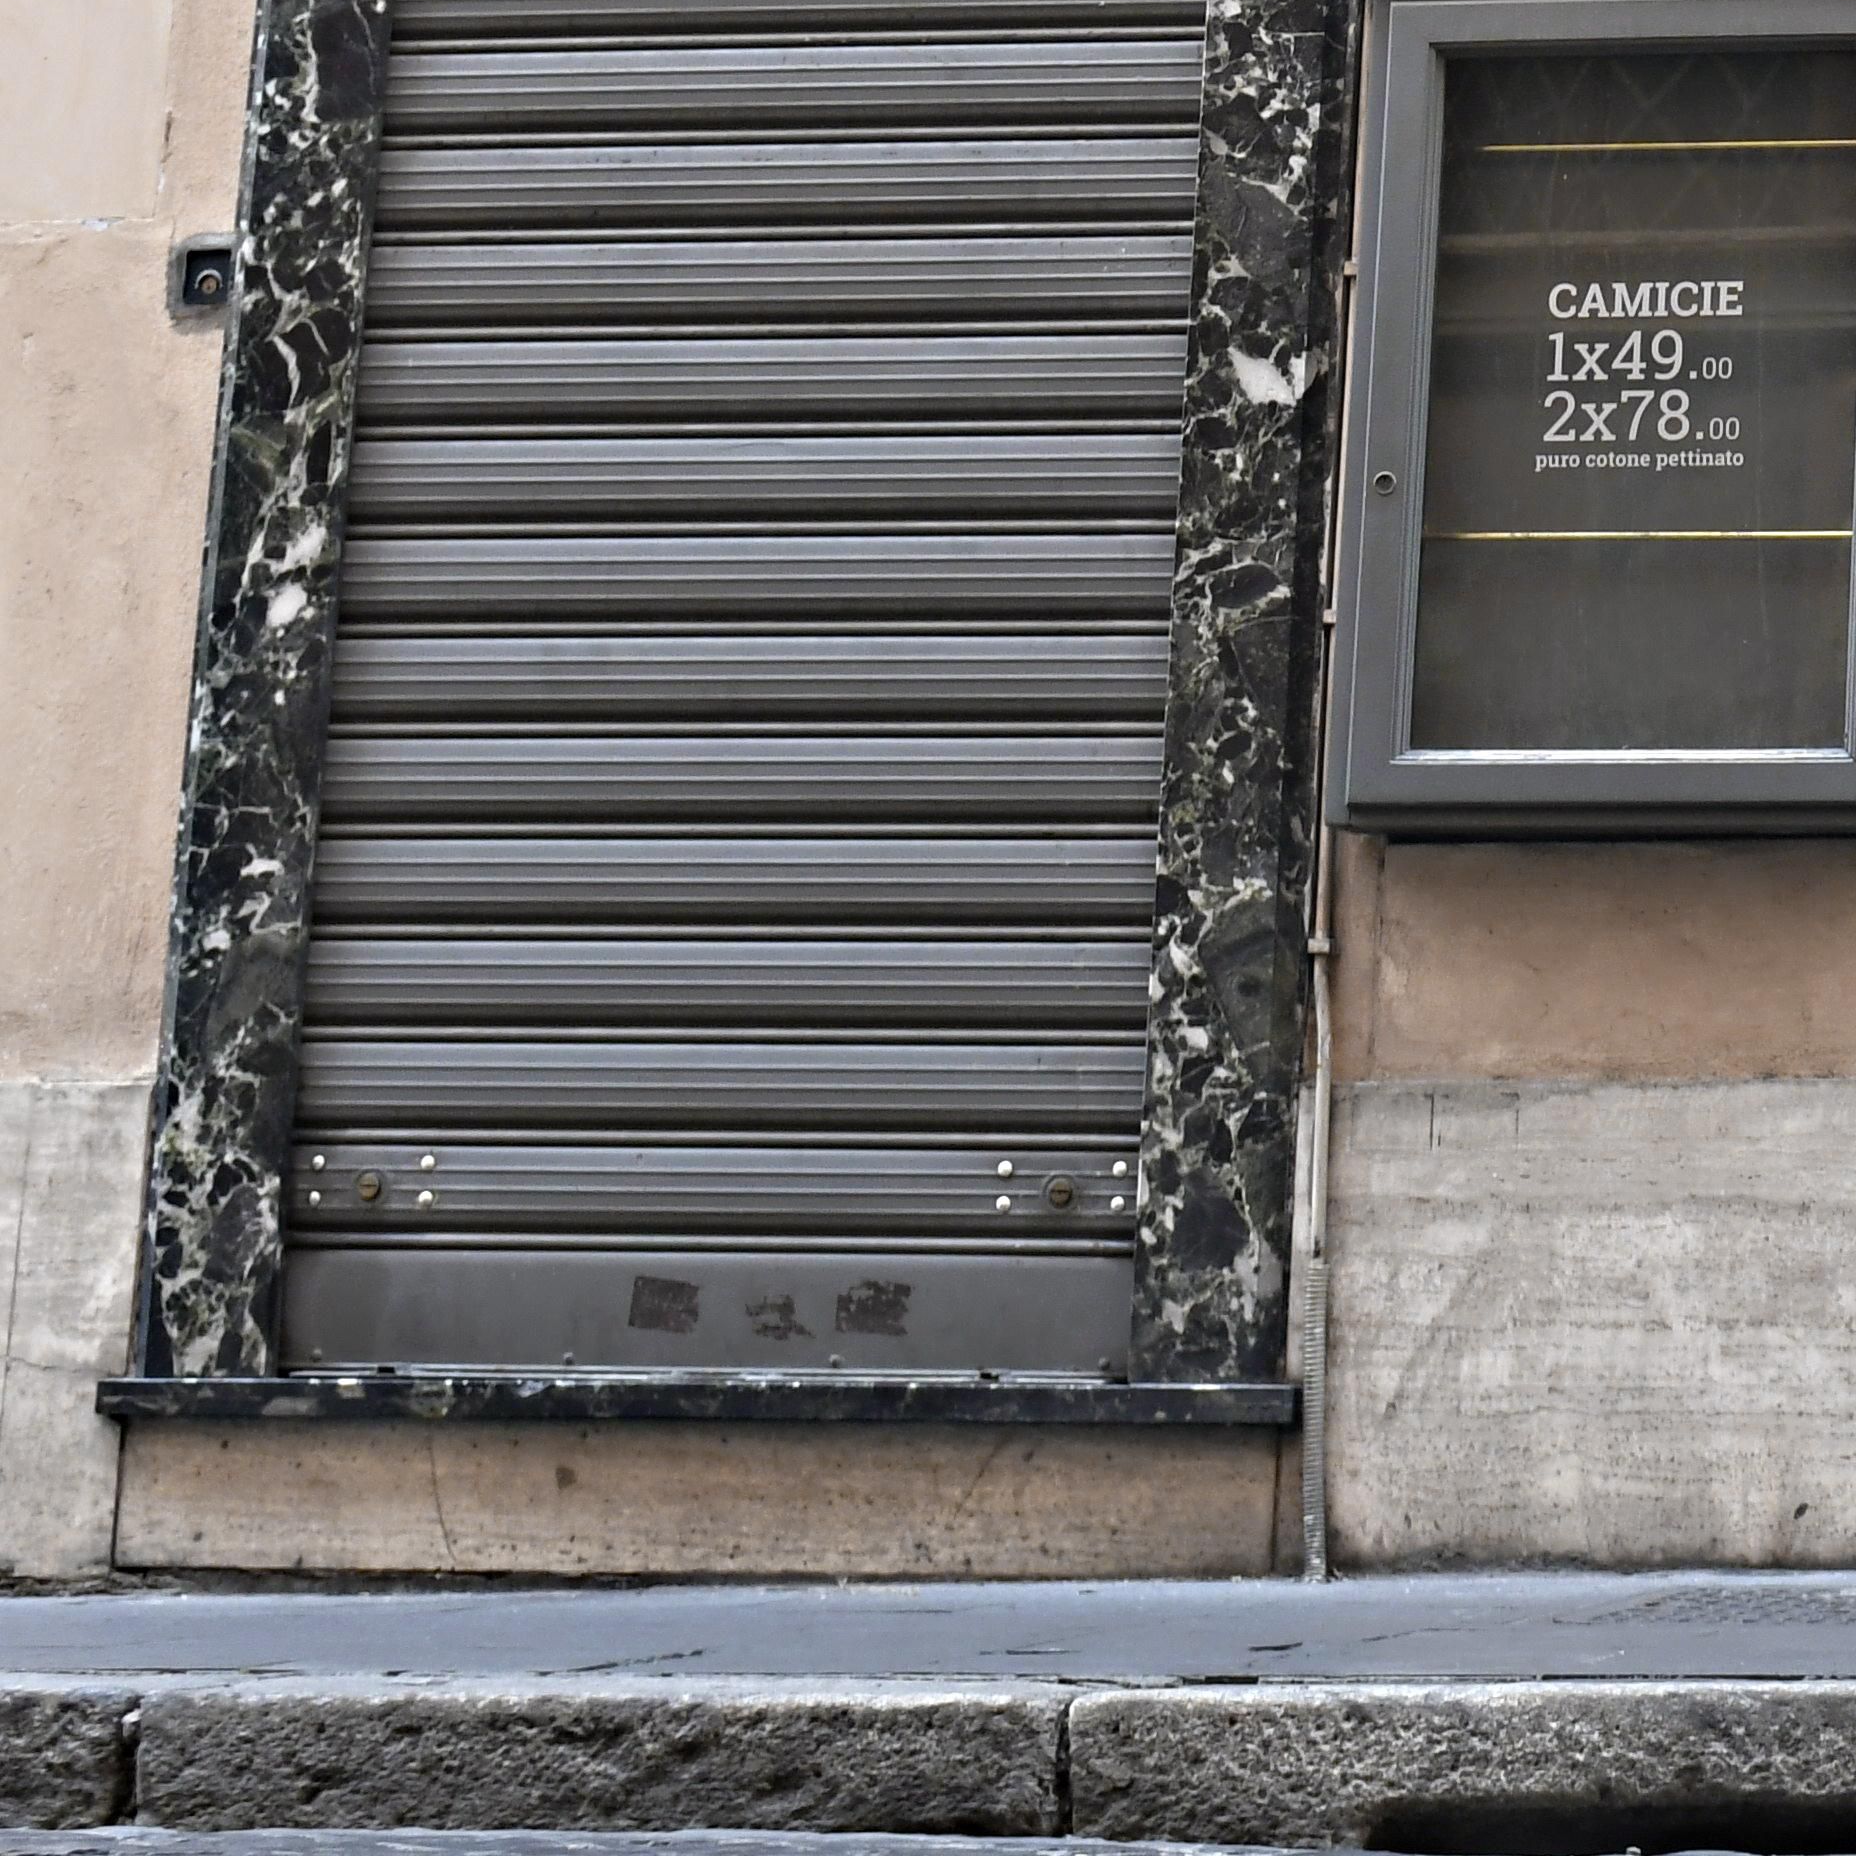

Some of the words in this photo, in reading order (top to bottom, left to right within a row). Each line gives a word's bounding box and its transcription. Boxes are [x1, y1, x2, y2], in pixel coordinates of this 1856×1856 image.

[1548, 280, 1744, 319] CAMICIE
[1546, 329, 1734, 382] 1x49.00
[1543, 388, 1741, 442] 2x78.00
[1534, 453, 1581, 472] puro
[1585, 451, 1651, 468] cotone
[1655, 448, 1745, 471] pettinato
